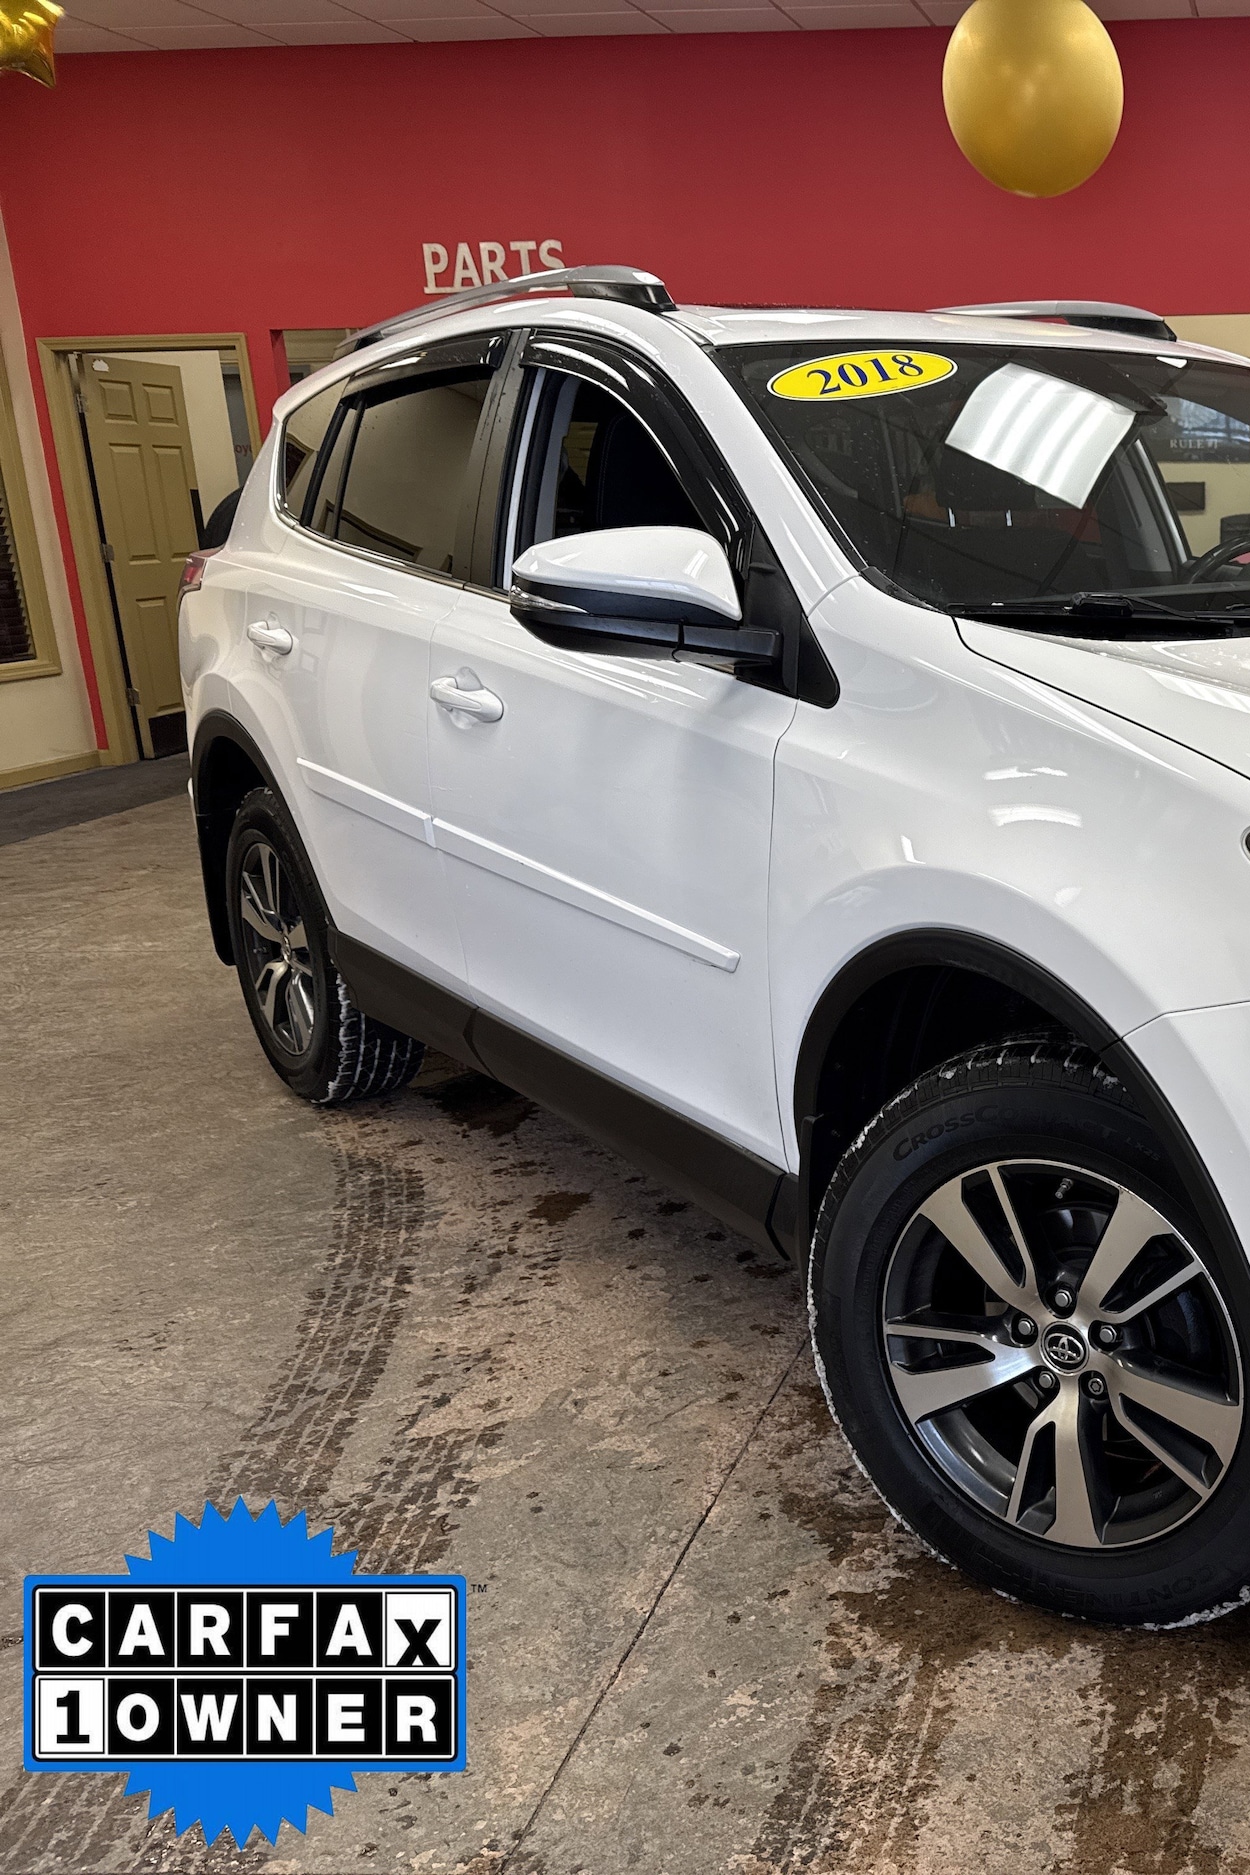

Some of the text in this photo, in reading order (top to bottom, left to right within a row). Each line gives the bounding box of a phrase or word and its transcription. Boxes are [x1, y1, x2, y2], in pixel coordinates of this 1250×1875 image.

[422, 239, 566, 288] PARTS
[806, 354, 924, 395] 2018
[1170, 439, 1205, 449] RULE
